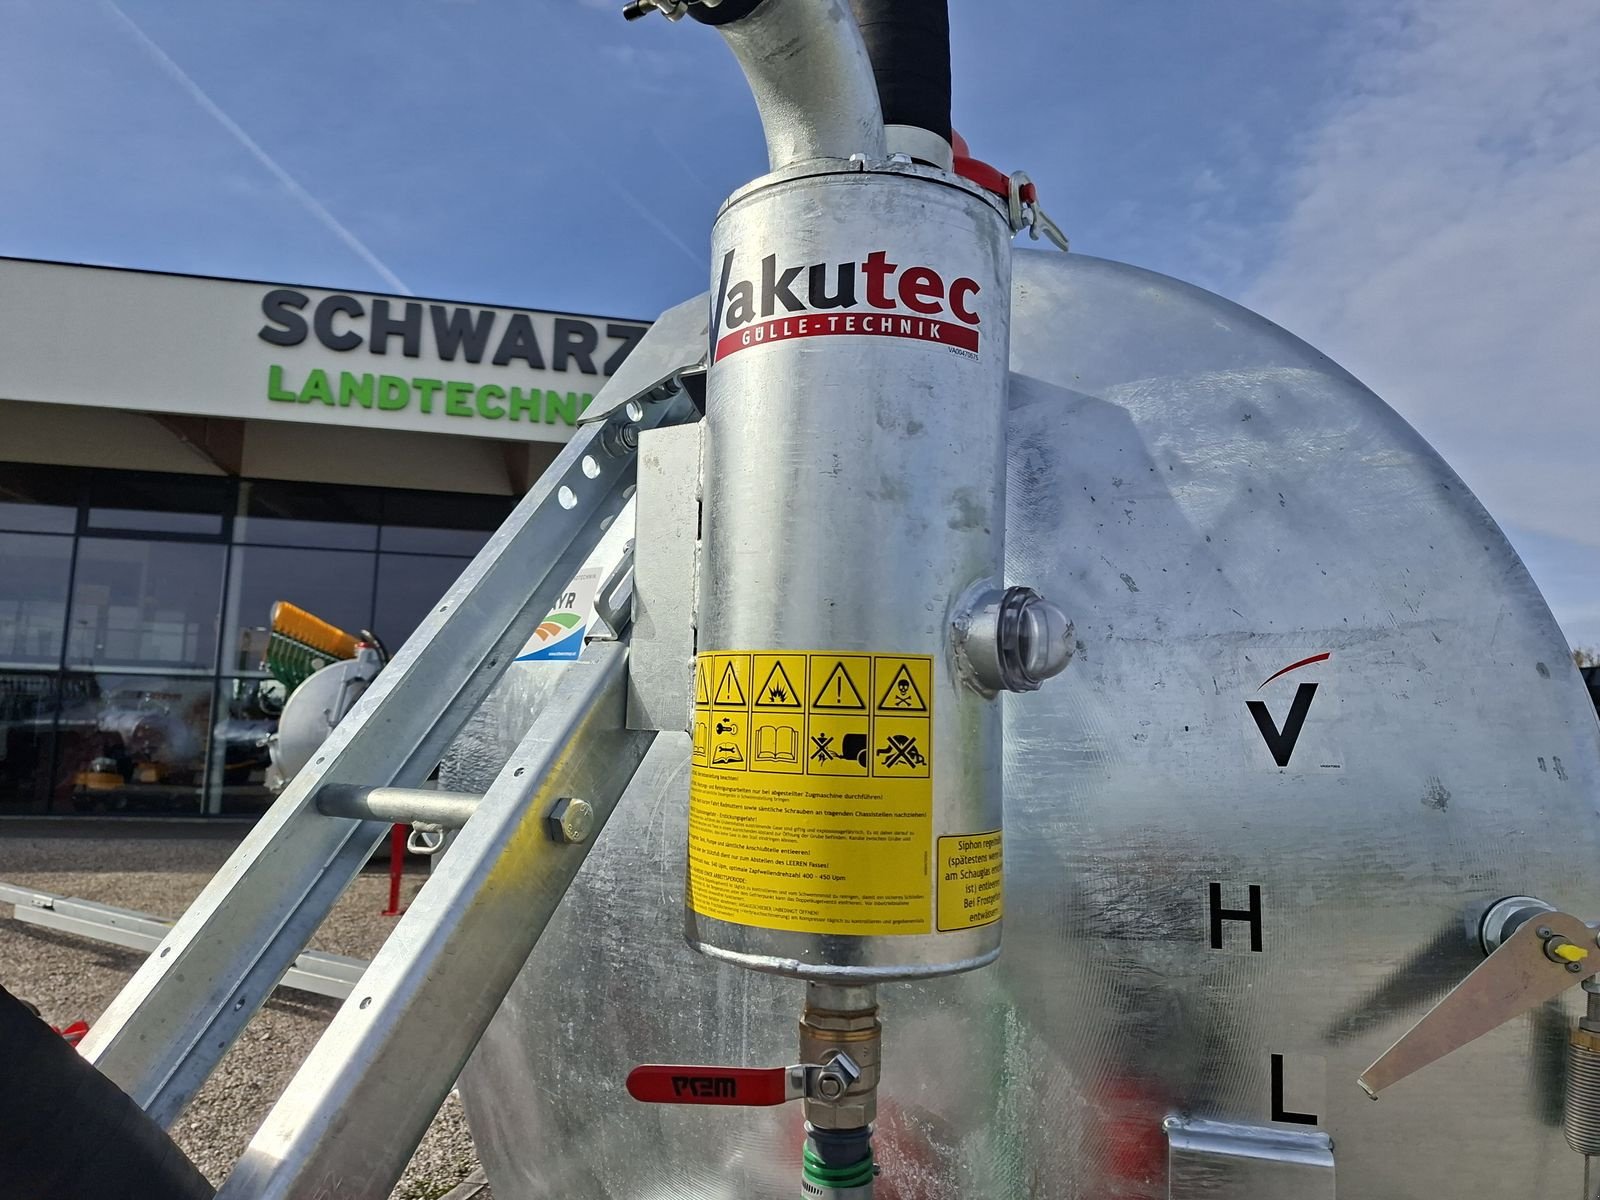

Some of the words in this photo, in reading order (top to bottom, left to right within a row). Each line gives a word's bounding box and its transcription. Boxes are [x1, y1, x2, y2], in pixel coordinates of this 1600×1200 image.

[709, 248, 981, 367] Vakutec
[258, 289, 648, 377] SCHWARZ
[742, 316, 941, 346] GÜLLE-TECHNIK
[1245, 683, 1319, 767] V
[746, 845, 780, 853] Anschlußteile
[958, 840, 982, 852] Siphon
[948, 854, 988, 868] (spätestens
[729, 865, 748, 873] optimale
[748, 868, 800, 879] Zapfwellendrehzahl
[945, 872, 958, 881] am
[960, 868, 990, 880] Schauglas
[965, 883, 977, 894] ist)
[964, 898, 975, 909] Bei
[1210, 883, 1262, 952] H
[1271, 1054, 1317, 1125] L
